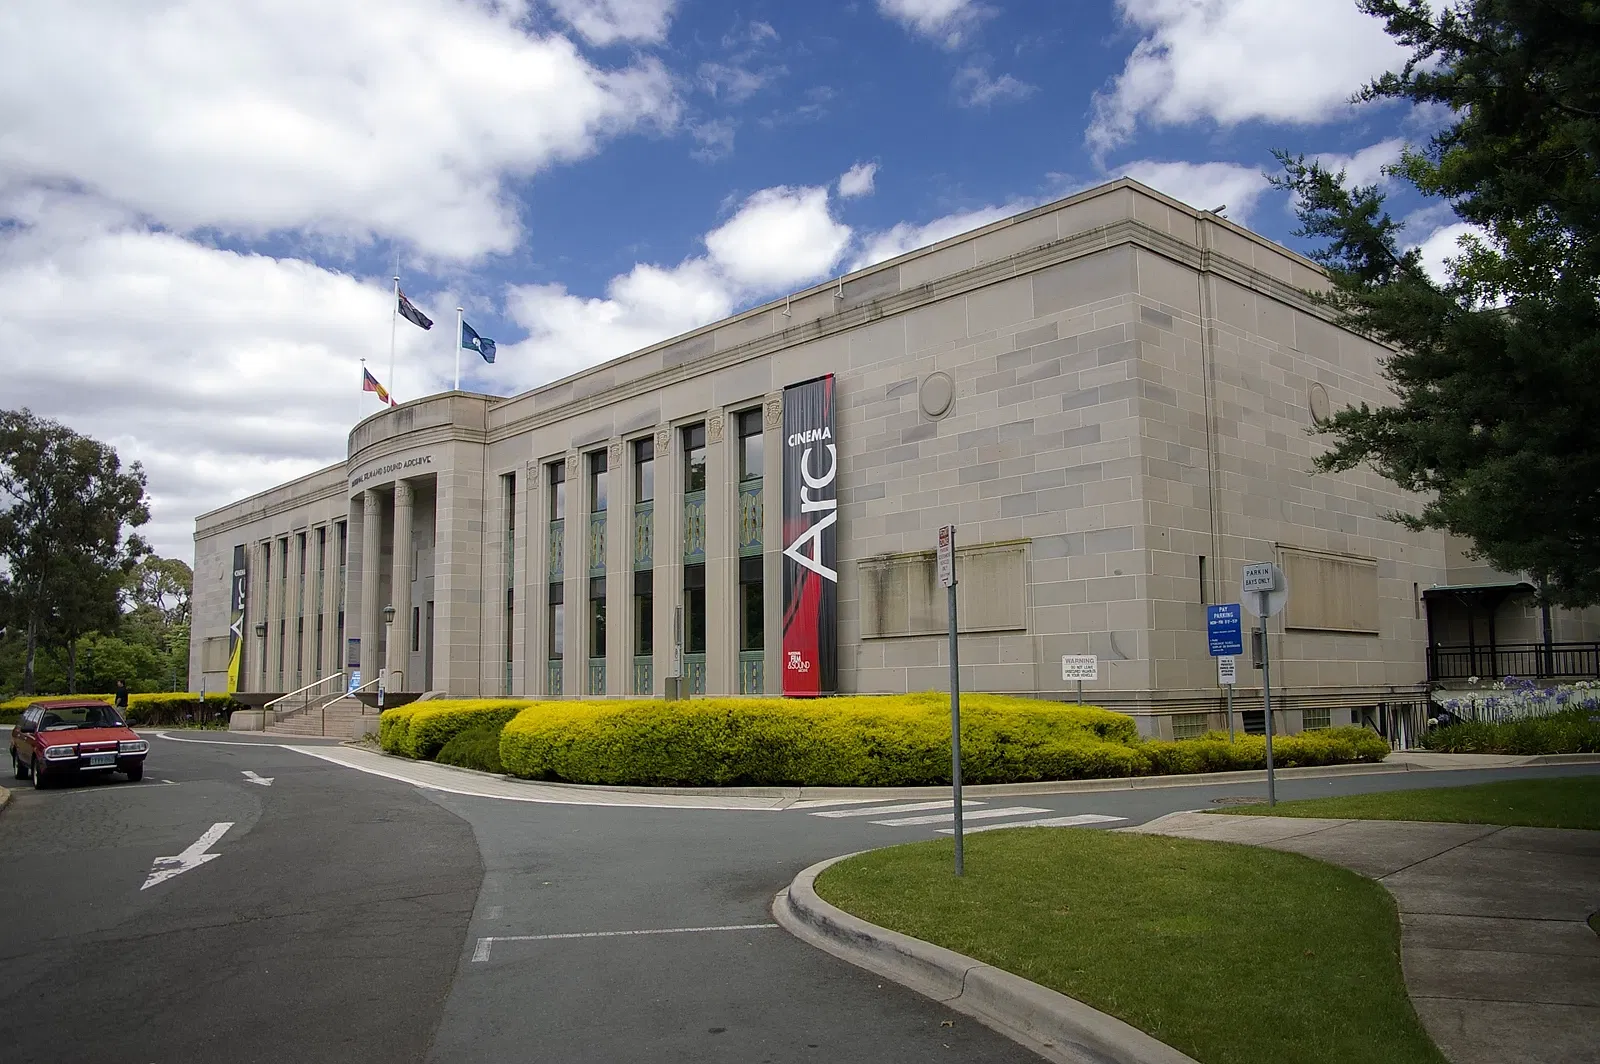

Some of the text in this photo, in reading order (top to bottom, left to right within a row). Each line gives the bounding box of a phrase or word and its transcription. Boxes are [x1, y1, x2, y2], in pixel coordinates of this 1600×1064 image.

[788, 426, 832, 447] CINEMA
[383, 462, 403, 475] SOUND
[403, 455, 431, 469] ARCHIVE
[783, 443, 838, 583] Arc
[1258, 577, 1270, 585] ONLY
[1213, 611, 1234, 619] PARKING
